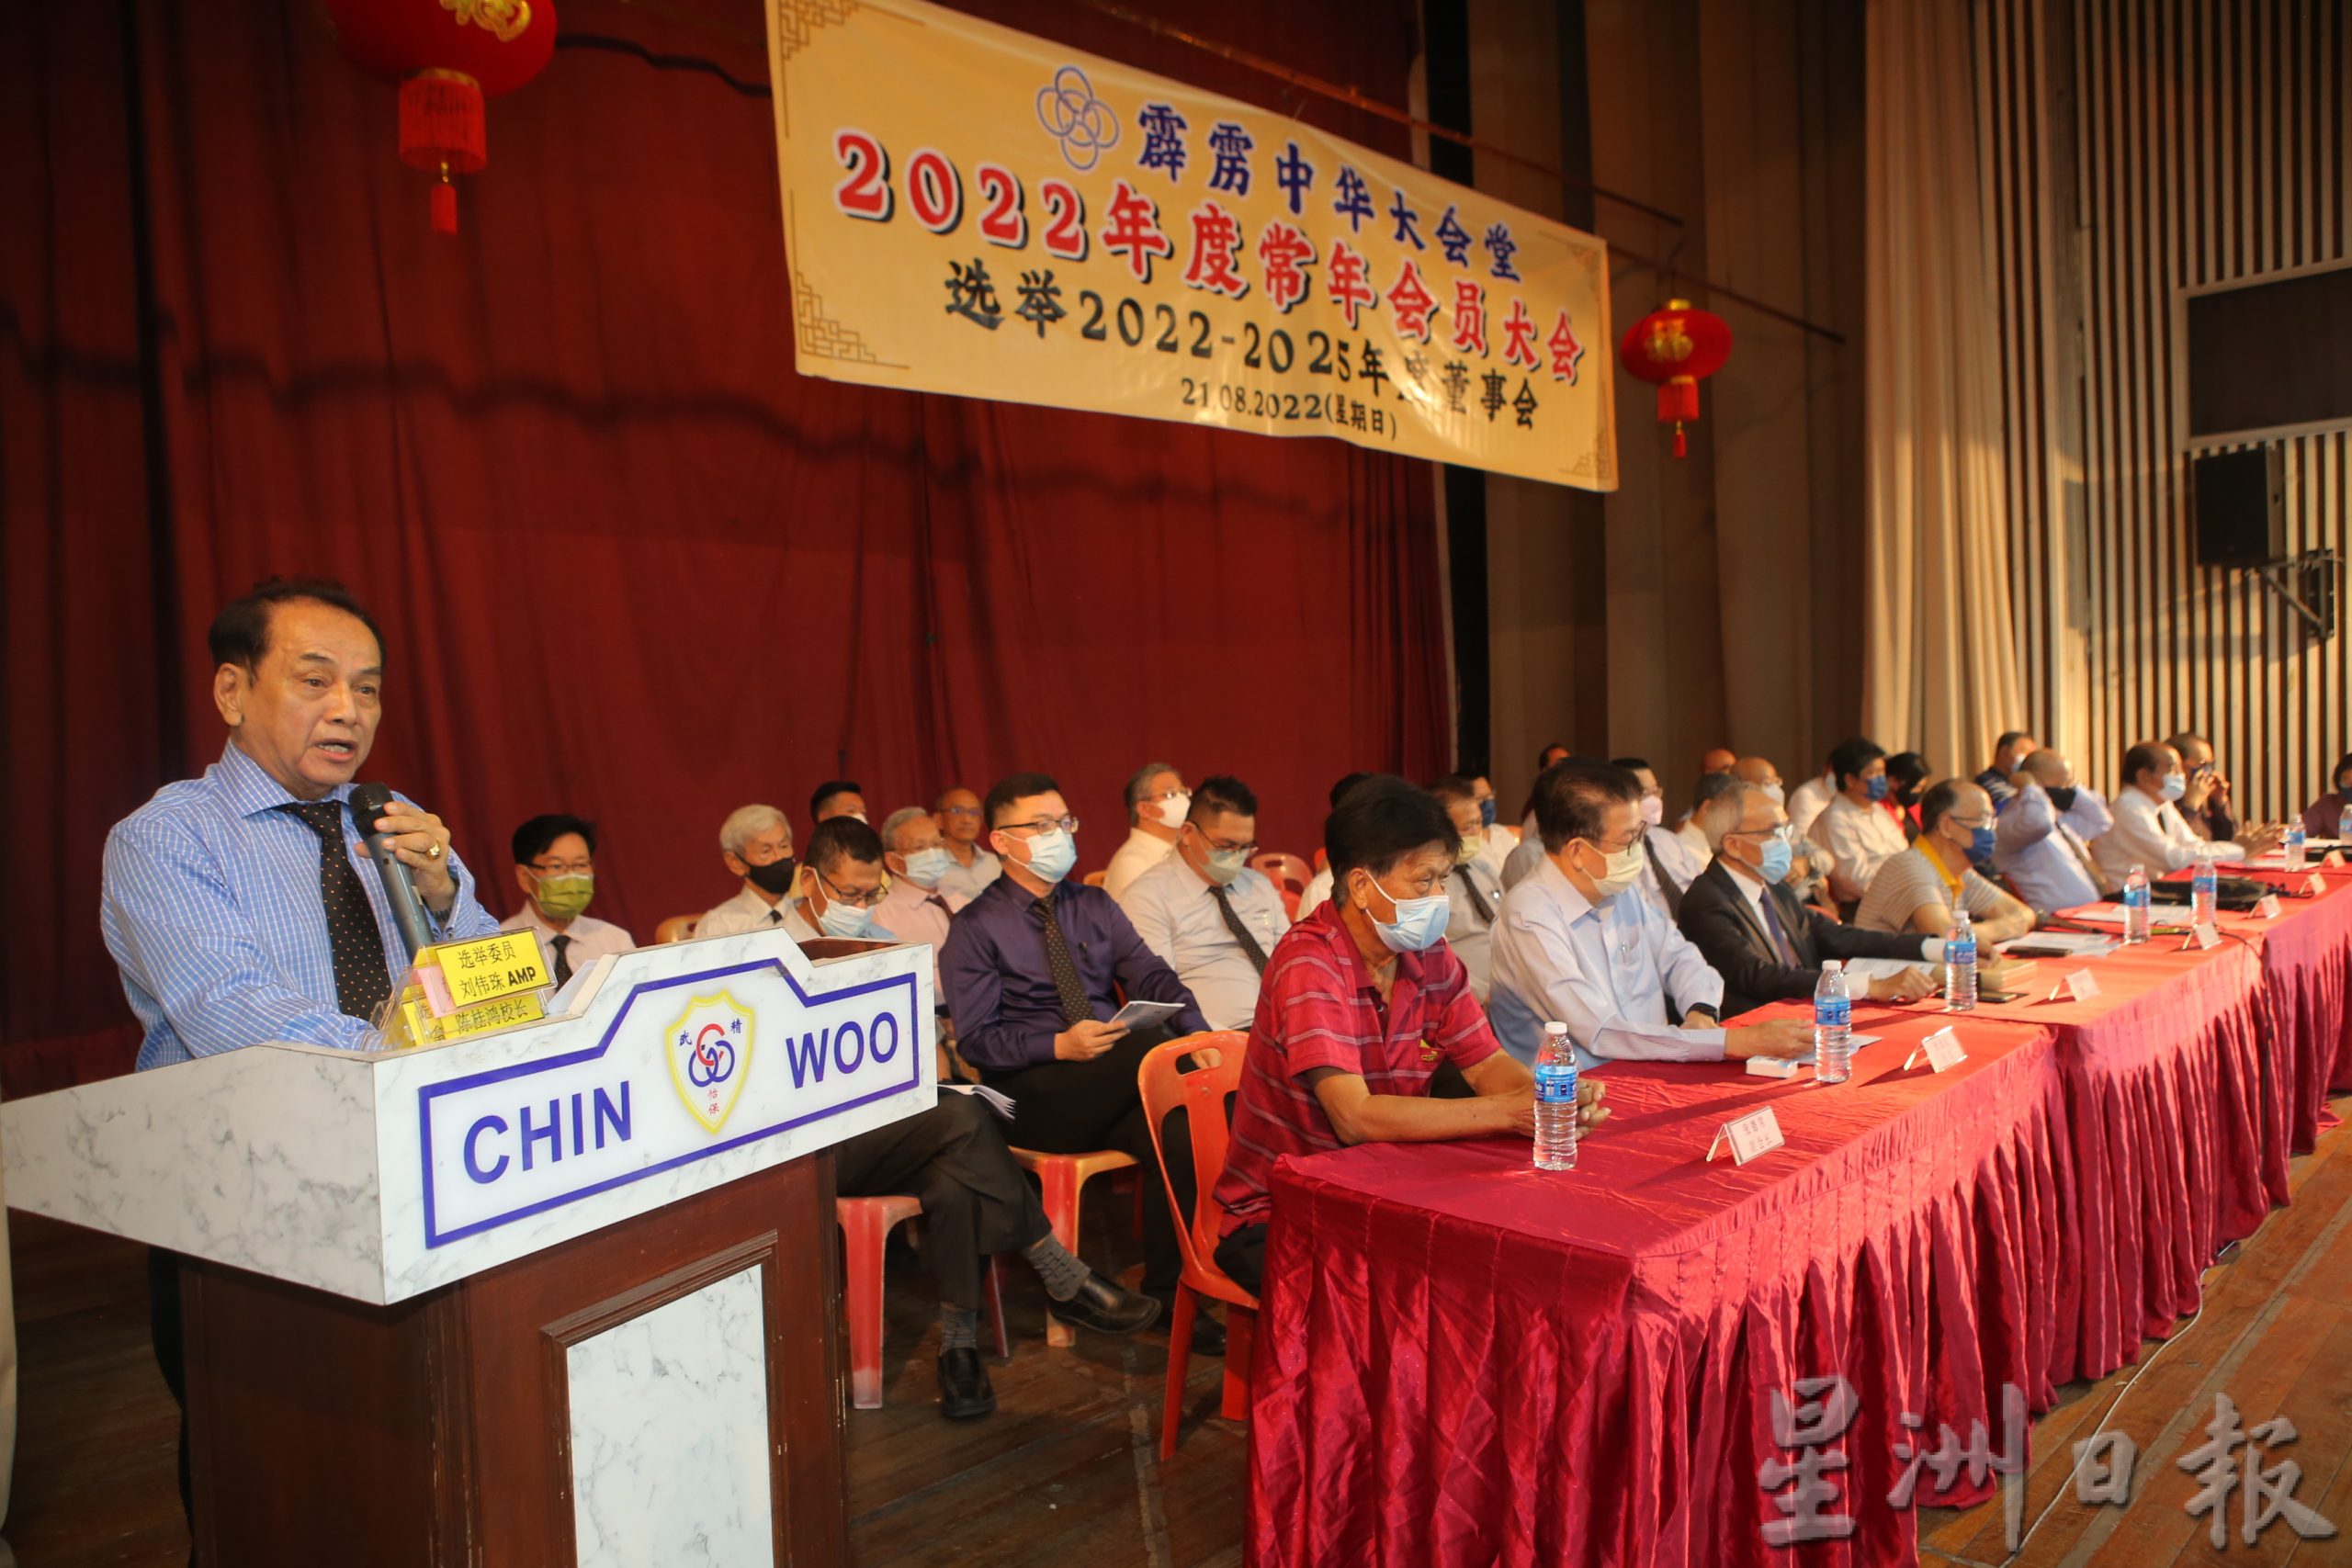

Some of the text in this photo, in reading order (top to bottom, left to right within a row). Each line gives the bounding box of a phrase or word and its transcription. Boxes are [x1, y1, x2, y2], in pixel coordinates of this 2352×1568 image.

[834, 130, 1585, 386] 2022年度常年会员大会
[1137, 104, 1522, 283] 霹雳中华大会堂
[458, 940, 516, 969] 选举委员
[459, 971, 505, 999] 刘伟珠
[507, 965, 537, 987] AMP
[462, 1011, 899, 1184] CHIN WOO
